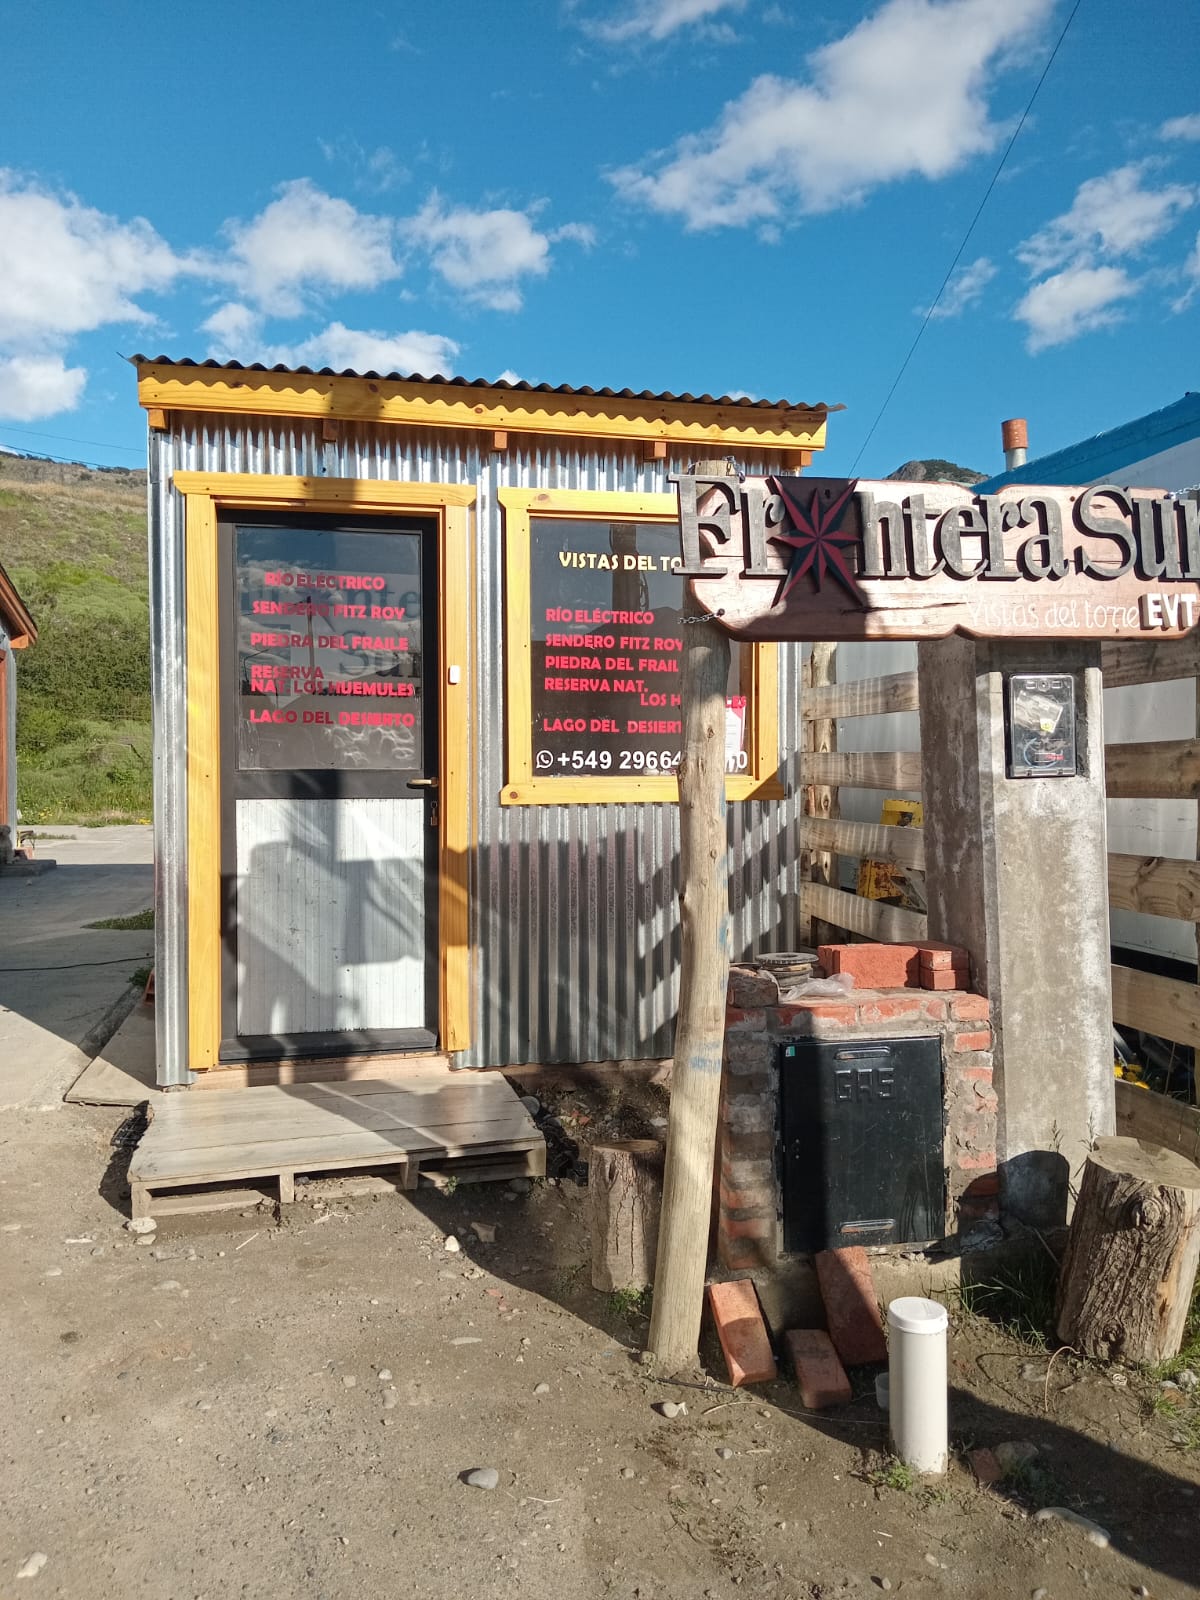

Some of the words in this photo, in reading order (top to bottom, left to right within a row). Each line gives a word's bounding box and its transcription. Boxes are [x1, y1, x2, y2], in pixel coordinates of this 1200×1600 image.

[667, 474, 1067, 580] Frntera
[559, 551, 619, 570] VISTAS
[623, 554, 657, 571] DEL
[265, 569, 295, 587] RÍO
[296, 571, 385, 591] ELÉCTRICO
[252, 601, 330, 617] SENDERO
[333, 604, 367, 619] FITZ
[371, 606, 405, 620] ROY
[546, 606, 573, 622] RÍO
[575, 608, 655, 625] ELÉCTRICO
[968, 599, 1040, 629] Vistas
[1045, 599, 1081, 629] del
[1144, 592, 1197, 628] EVT
[251, 632, 314, 648] PIEDRA
[318, 635, 349, 650] DEL
[352, 636, 409, 651] FRAILE
[545, 633, 615, 649] SENDERO
[620, 636, 650, 650] FITZ
[251, 664, 324, 680] RESERVA
[545, 656, 601, 670] PIEDRA
[605, 657, 634, 672] DEL
[639, 659, 679, 673] FRAIL
[294, 681, 323, 695] LOS
[329, 681, 415, 697] HUEMULES
[544, 677, 611, 692] RESERVA
[613, 679, 649, 694] NAT.
[640, 693, 667, 707] LOS
[250, 709, 297, 724] LAGO
[302, 711, 334, 725] DEL
[338, 711, 415, 727] DESIERTO
[543, 718, 587, 733] LAGO
[590, 720, 620, 734] DEL
[627, 720, 683, 734] DESIERT
[557, 750, 612, 769] +549
[835, 1068, 895, 1100] GAS
